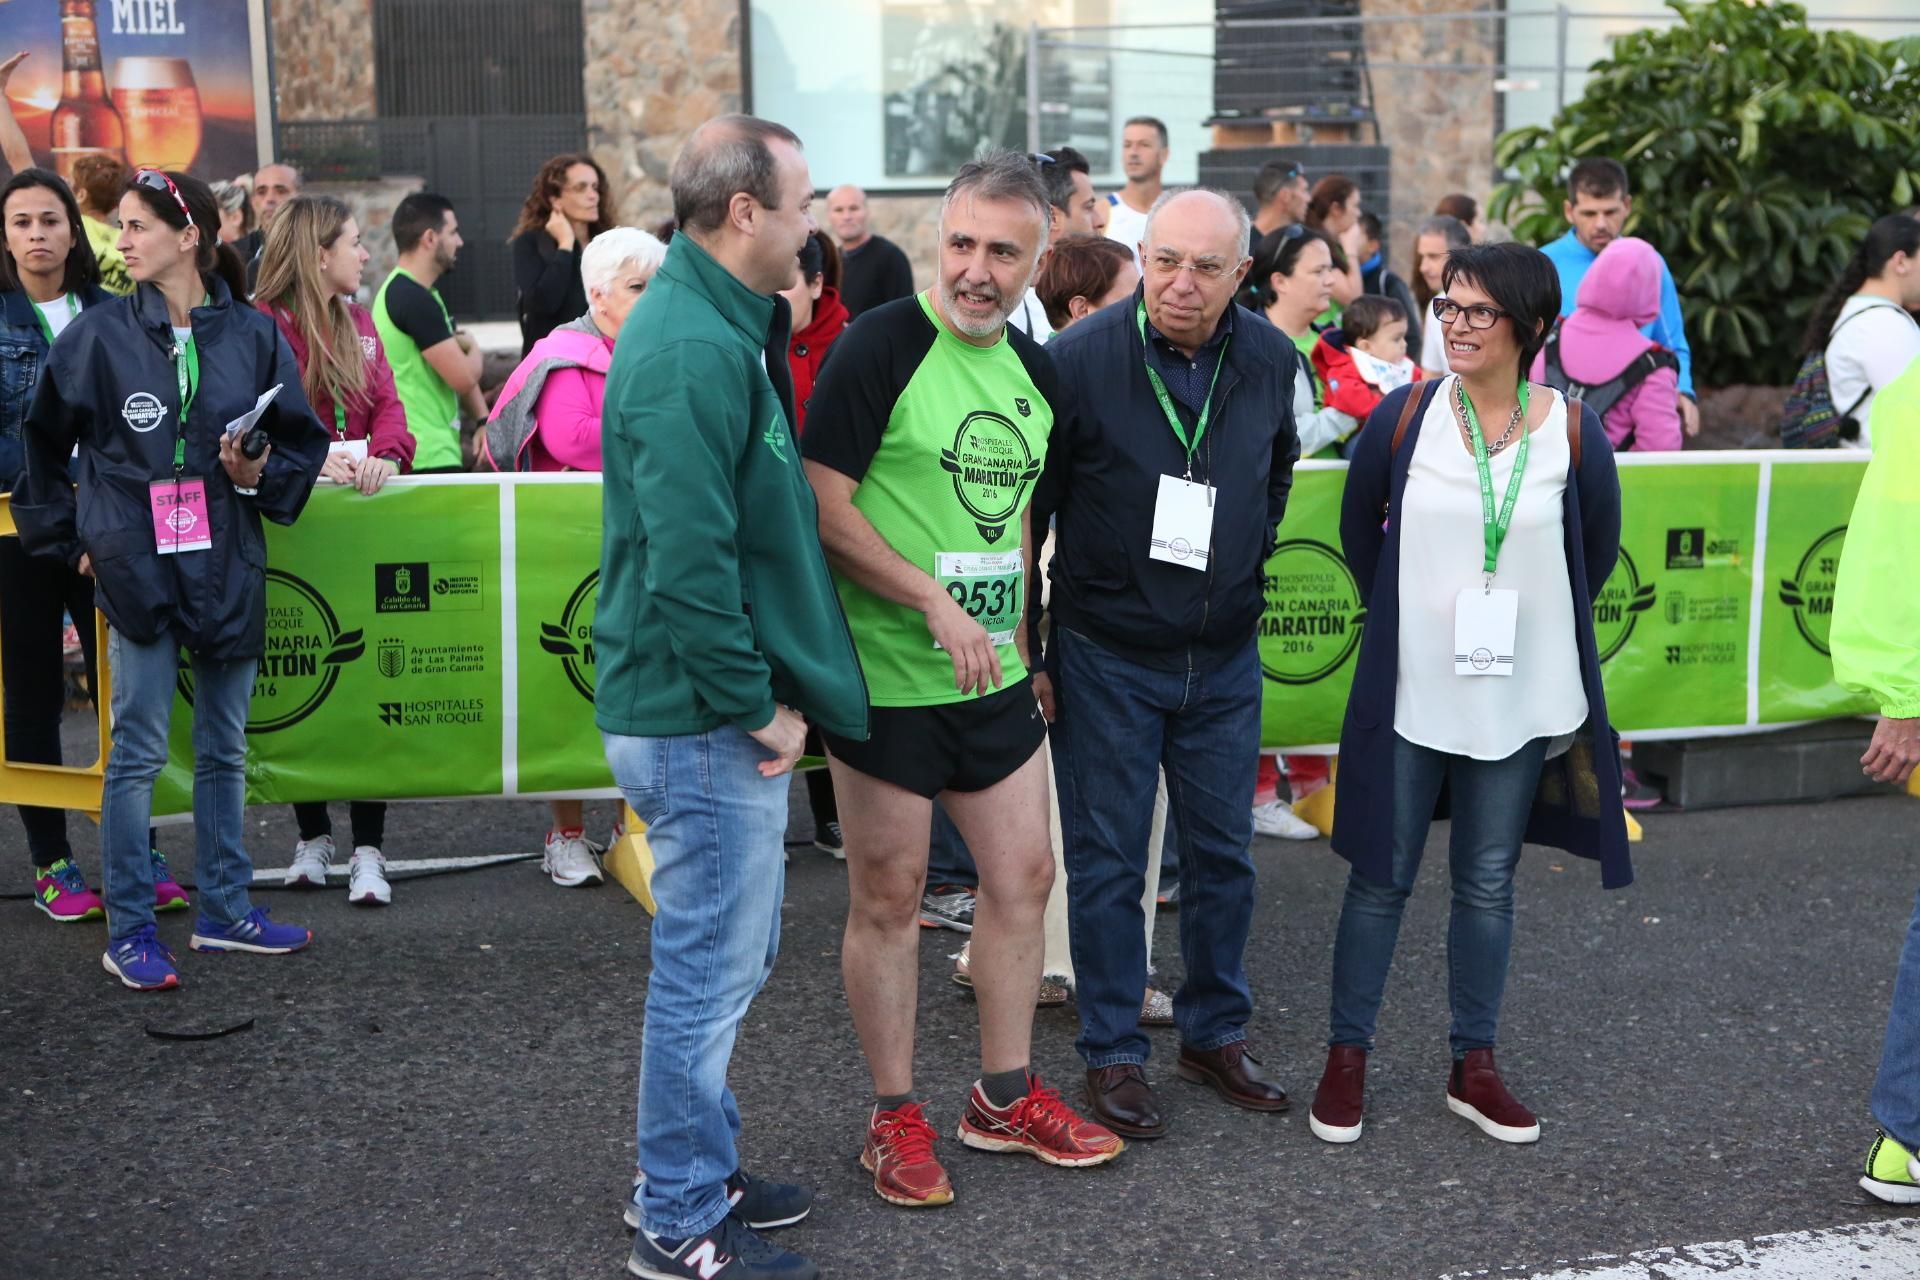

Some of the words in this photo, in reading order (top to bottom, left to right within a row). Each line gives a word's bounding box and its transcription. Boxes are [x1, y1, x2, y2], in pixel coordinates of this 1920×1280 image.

[111, 0, 186, 34] MIEL
[989, 446, 1014, 455] ROQUE
[962, 453, 982, 467] GRAN
[983, 457, 1023, 470] CANARIA
[963, 467, 1018, 488] MARATÓN
[156, 491, 201, 506] STAFF
[982, 487, 998, 499] 2016
[384, 595, 410, 603] Cabildo
[411, 595, 421, 603] de
[945, 576, 1018, 618] 9531
[1599, 588, 1627, 601] ARIA
[266, 606, 304, 618] ITALES
[1266, 600, 1285, 613] AN
[1289, 599, 1351, 612] CANARIA
[265, 618, 304, 630] OQUE
[267, 635, 323, 650] NARIA
[1283, 641, 1314, 653] 2016
[411, 644, 484, 656] Ayuntamiento
[257, 647, 317, 677] ATÓN
[411, 656, 423, 664] de
[429, 655, 444, 664] Las
[449, 654, 484, 663] Palmas
[411, 666, 423, 674] de
[425, 665, 447, 673] Gran
[449, 663, 484, 672] Canaria
[404, 698, 484, 713] HOSPITALES
[404, 713, 430, 727] SAN
[436, 711, 484, 725] ROQUE
